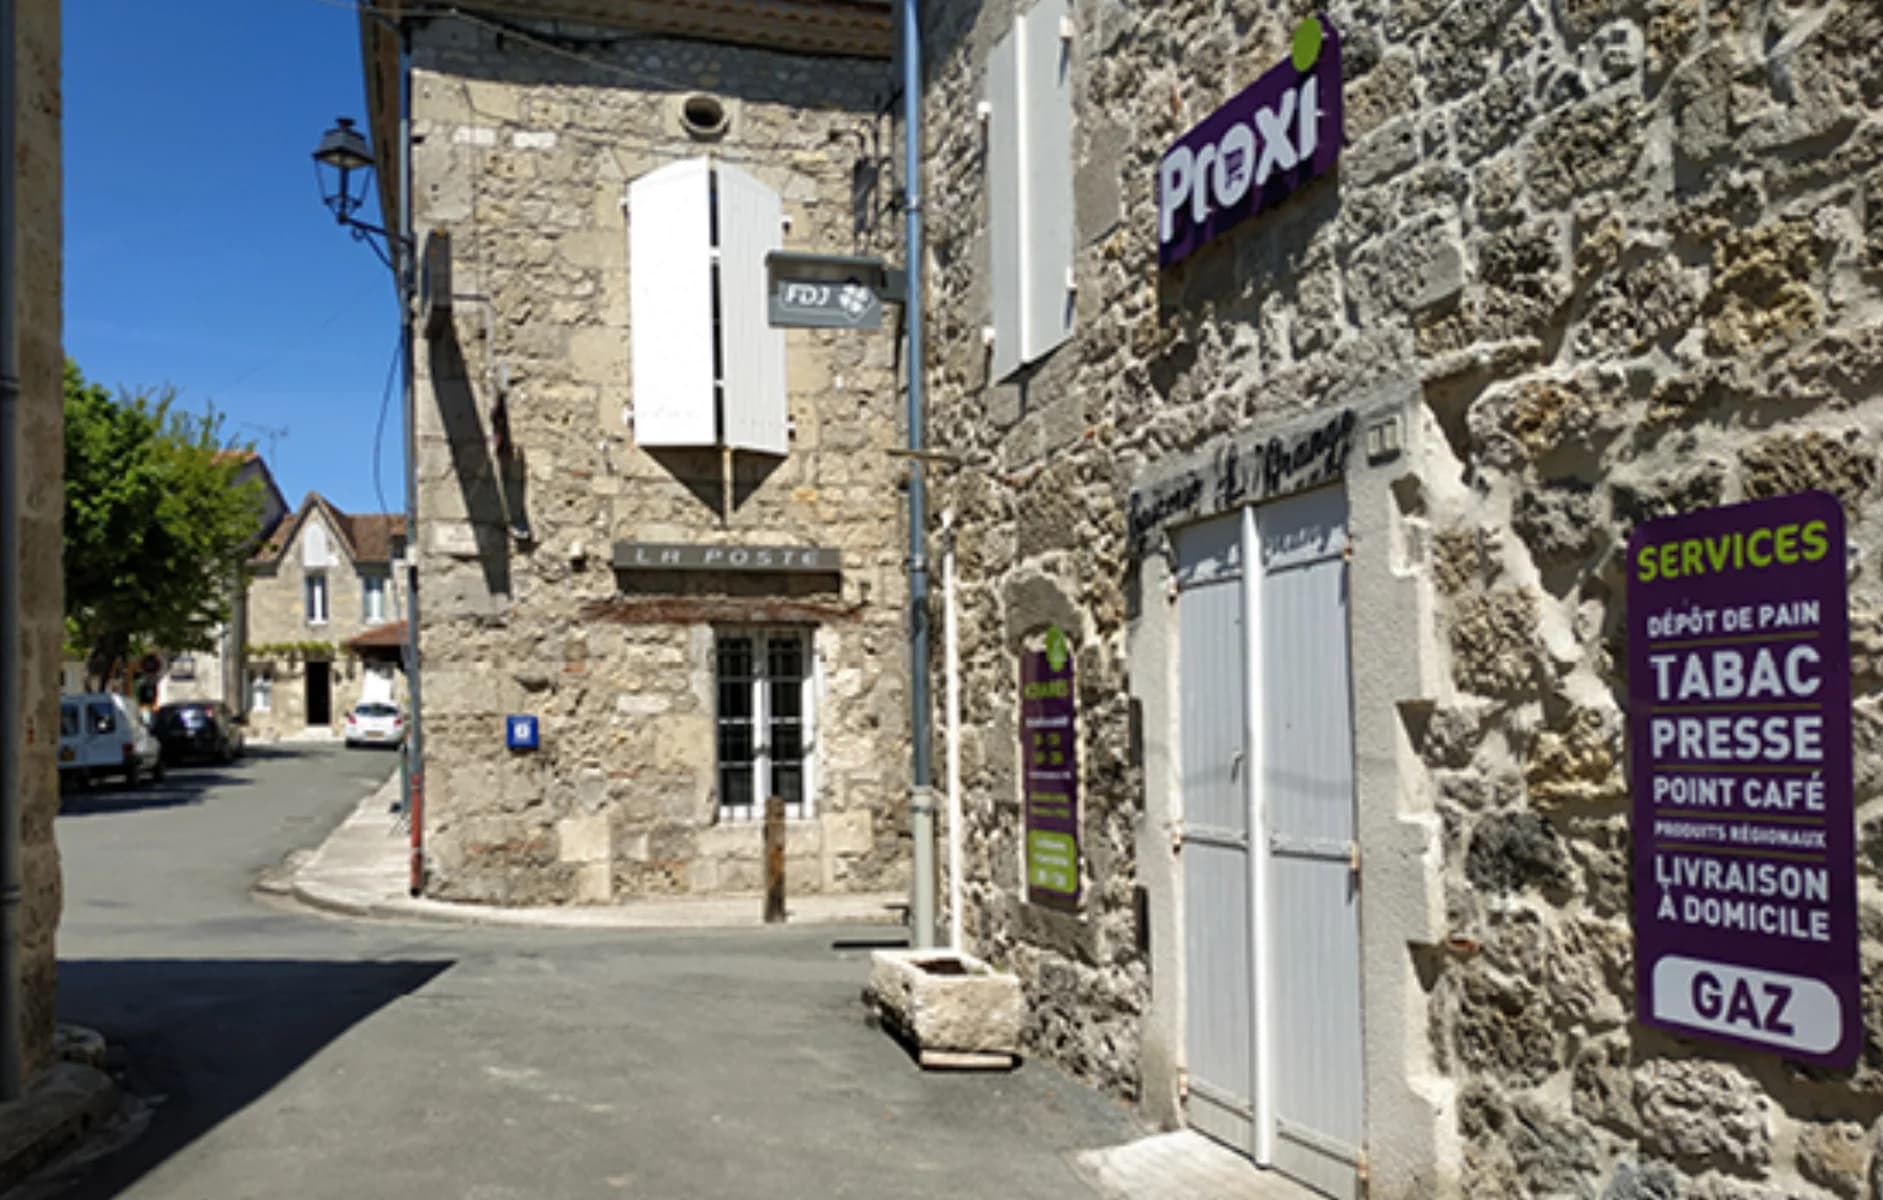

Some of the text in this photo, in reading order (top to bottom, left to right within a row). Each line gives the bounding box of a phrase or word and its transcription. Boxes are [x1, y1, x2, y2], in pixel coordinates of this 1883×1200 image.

[785, 284, 830, 305] FDJ
[636, 549, 819, 566] LA POSTE
[1637, 520, 1828, 582] SERVICES
[1647, 601, 1820, 637] DÉPÔT DE PAIN
[1649, 644, 1821, 700] TABAC
[1652, 716, 1823, 760] PRESSE
[1653, 772, 1826, 810] POINT CAFÉ
[1654, 820, 1826, 848] PRODUITS RÉGIONAUX
[1656, 854, 1829, 901] LIVRAISON
[1657, 883, 1830, 941] À DOMICILE
[1692, 970, 1795, 1036] GAZ
